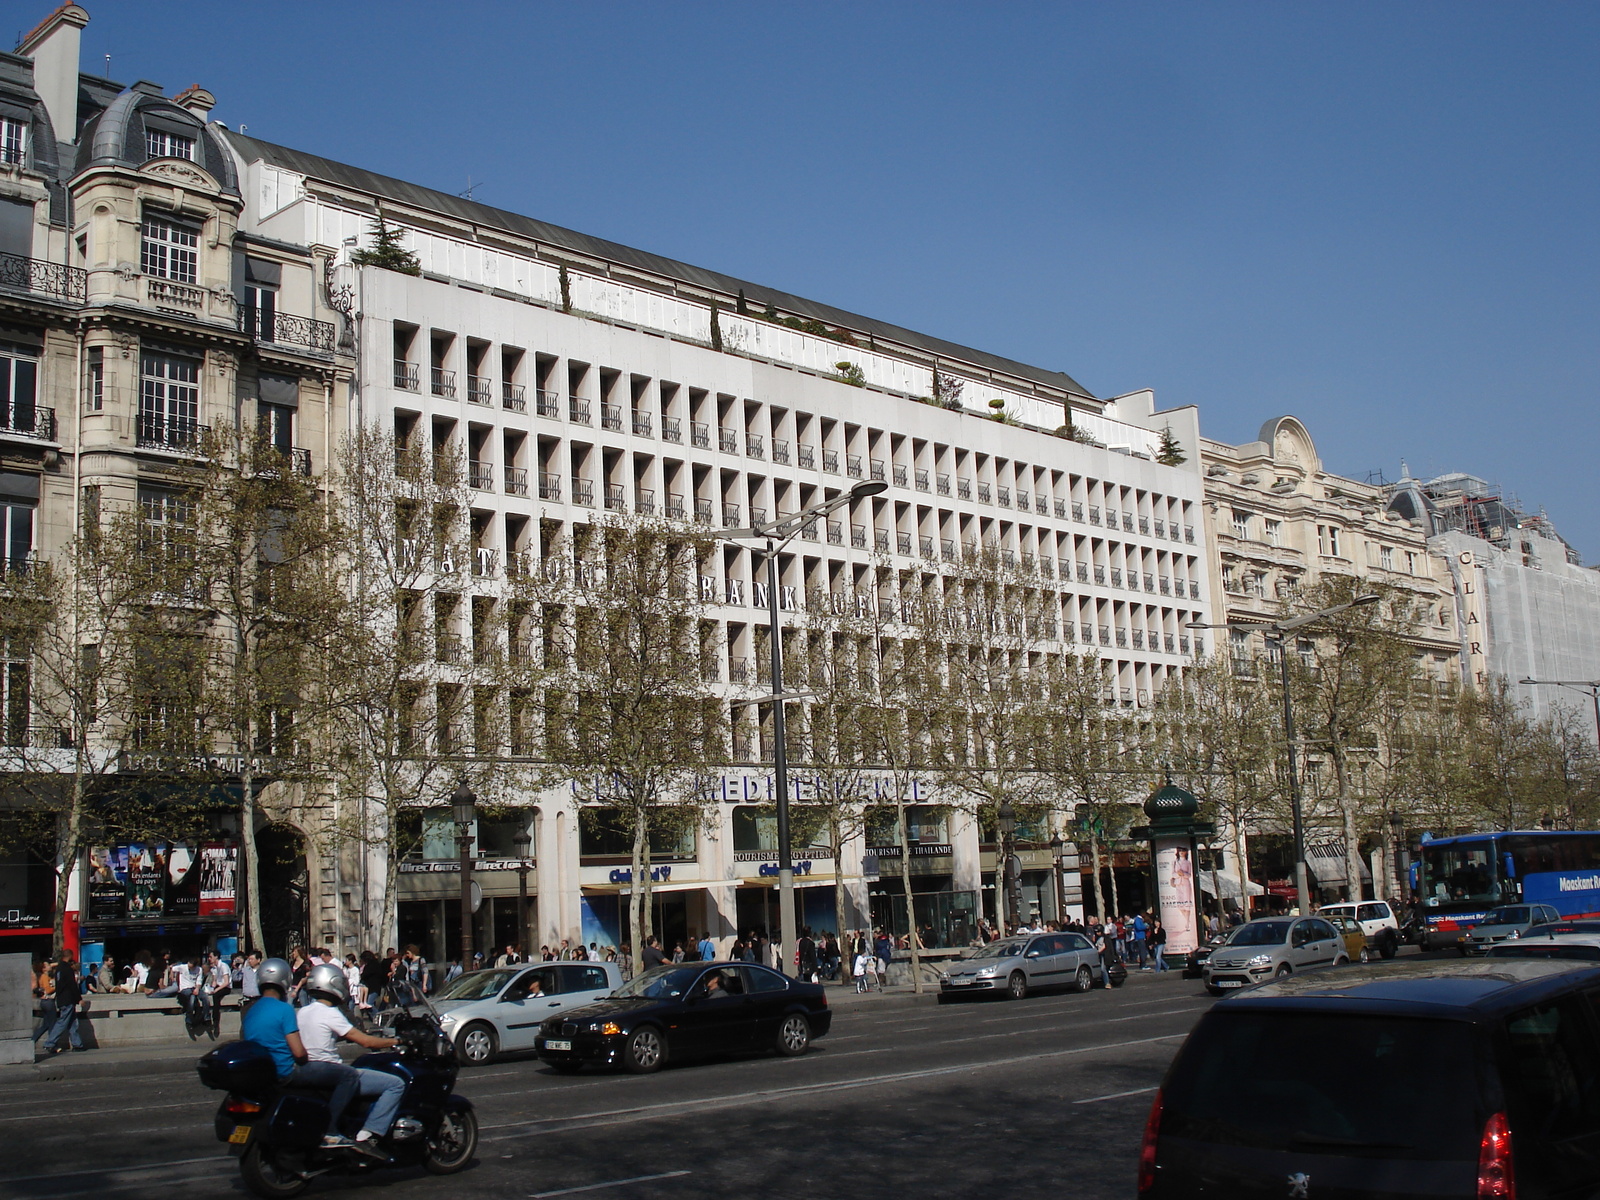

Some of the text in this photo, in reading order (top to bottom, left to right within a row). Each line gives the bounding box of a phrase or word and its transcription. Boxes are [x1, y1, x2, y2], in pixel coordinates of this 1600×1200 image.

[202, 847, 237, 858] ROMANO
[733, 850, 831, 862] TOURISME GYPTIEN
[865, 847, 900, 857] TOURISME
[915, 845, 952, 855] THAILANDE
[1559, 876, 1593, 891] Maaskant
